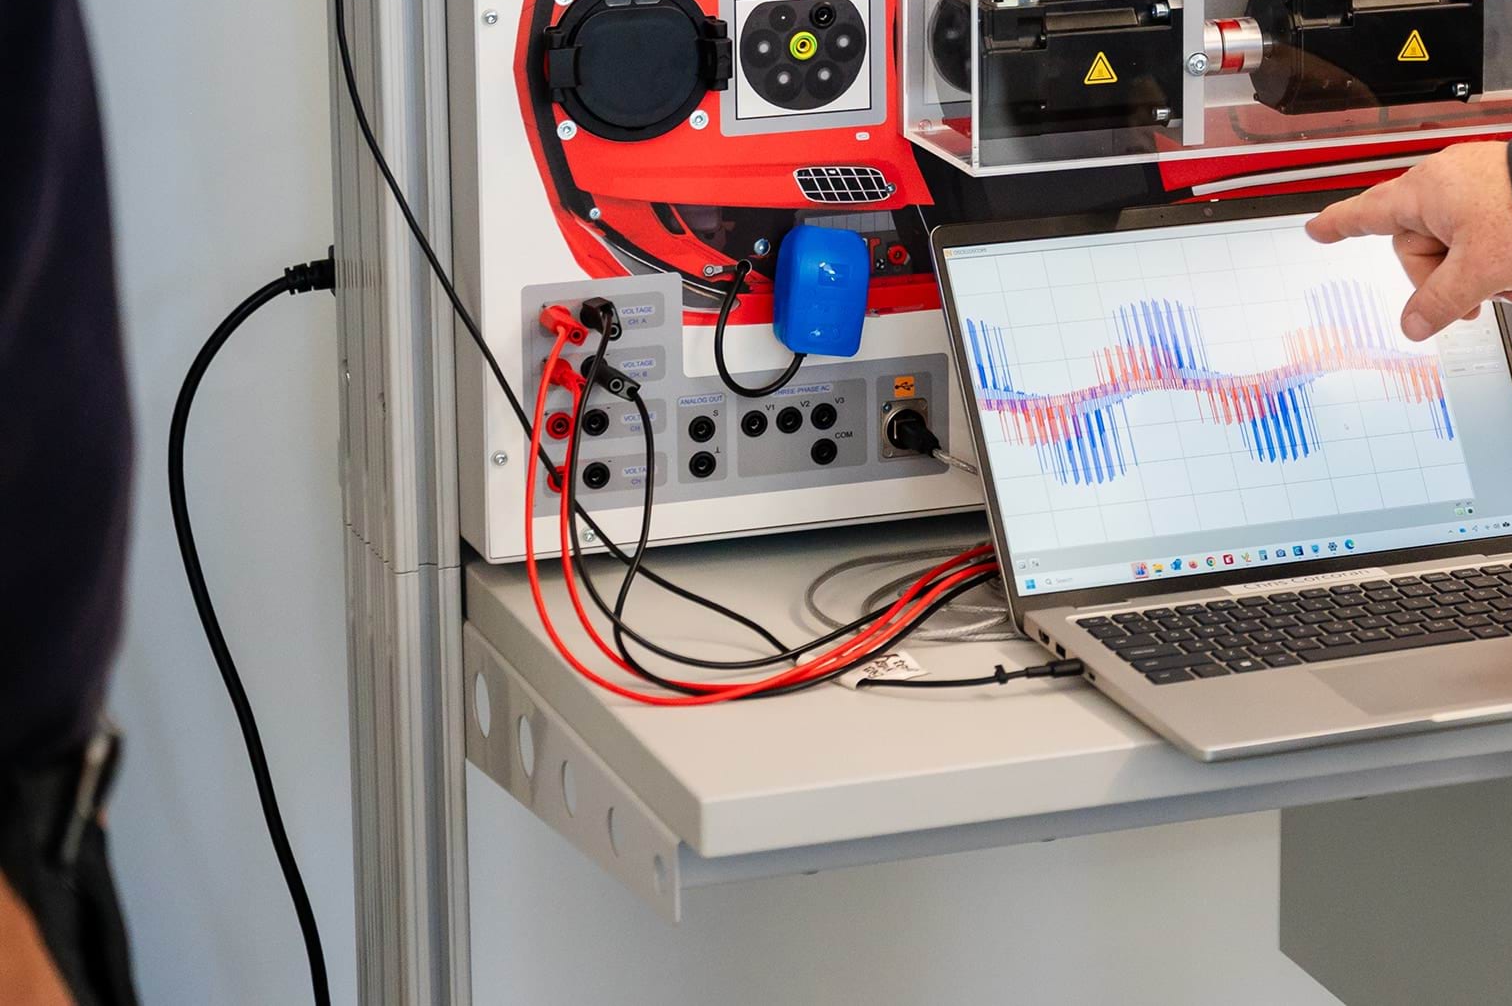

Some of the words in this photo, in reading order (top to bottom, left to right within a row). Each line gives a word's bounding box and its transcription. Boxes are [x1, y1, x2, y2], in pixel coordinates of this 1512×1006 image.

[621, 306, 653, 316] VOLTAGE
[627, 318, 639, 327] CH
[641, 317, 648, 326] A
[622, 359, 654, 369] VOLTAGE
[797, 385, 819, 394] PHASE
[820, 384, 831, 393] AC
[679, 396, 708, 407] ANALOG
[709, 394, 723, 404] OUT
[800, 400, 811, 409] V2
[835, 396, 845, 405] V3
[765, 403, 775, 412] V1
[623, 413, 656, 423] VOLTE
[713, 409, 719, 418] S
[835, 430, 853, 440] COM
[624, 466, 648, 476] VOLTA
